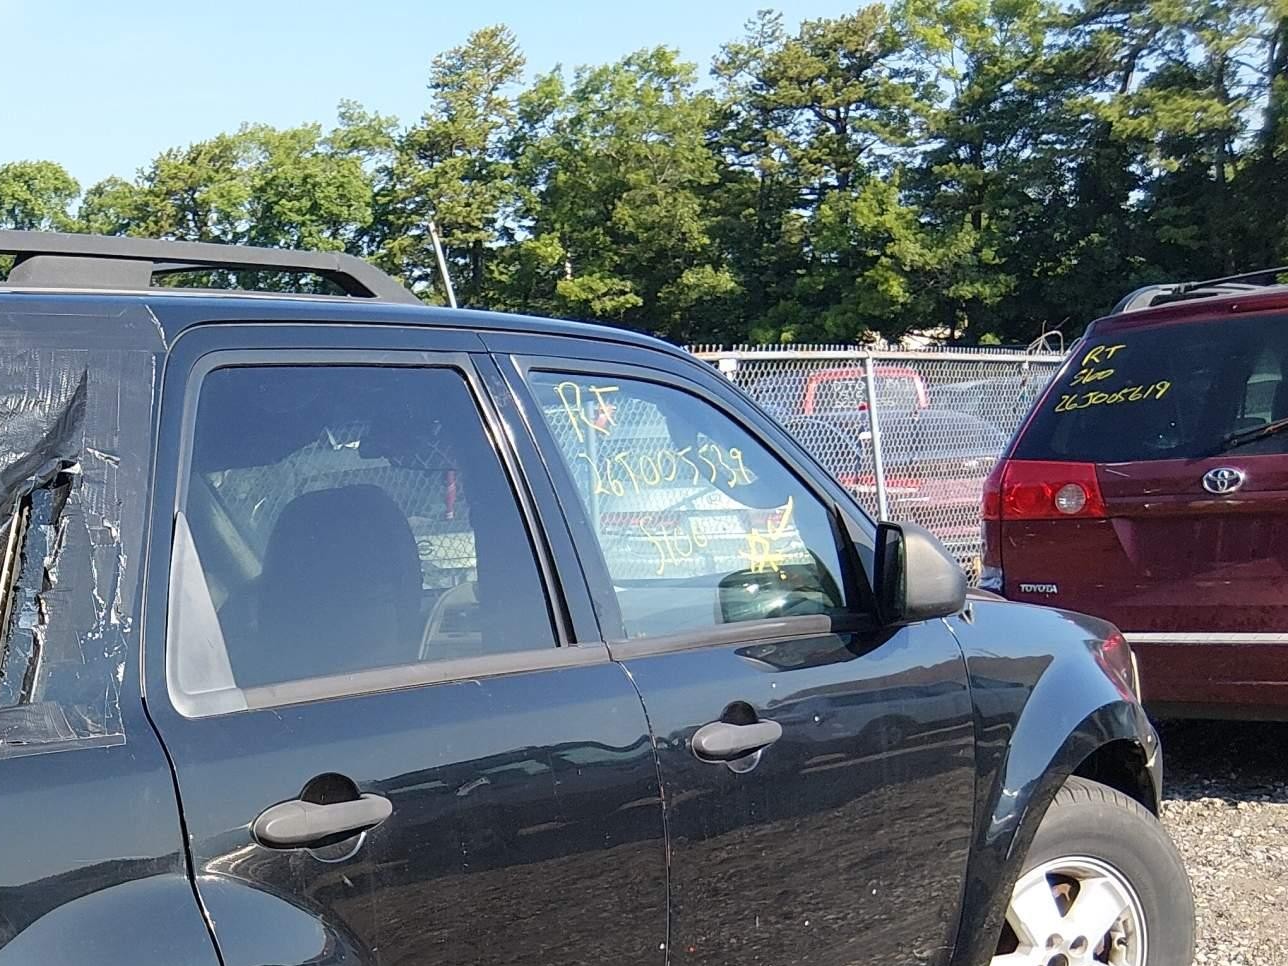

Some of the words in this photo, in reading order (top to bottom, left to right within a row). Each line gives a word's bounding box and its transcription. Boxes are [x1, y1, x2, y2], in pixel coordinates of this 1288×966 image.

[1082, 345, 1127, 366] RT
[1055, 381, 1171, 412] 26J005619
[1019, 584, 1058, 594] TOYOTA
